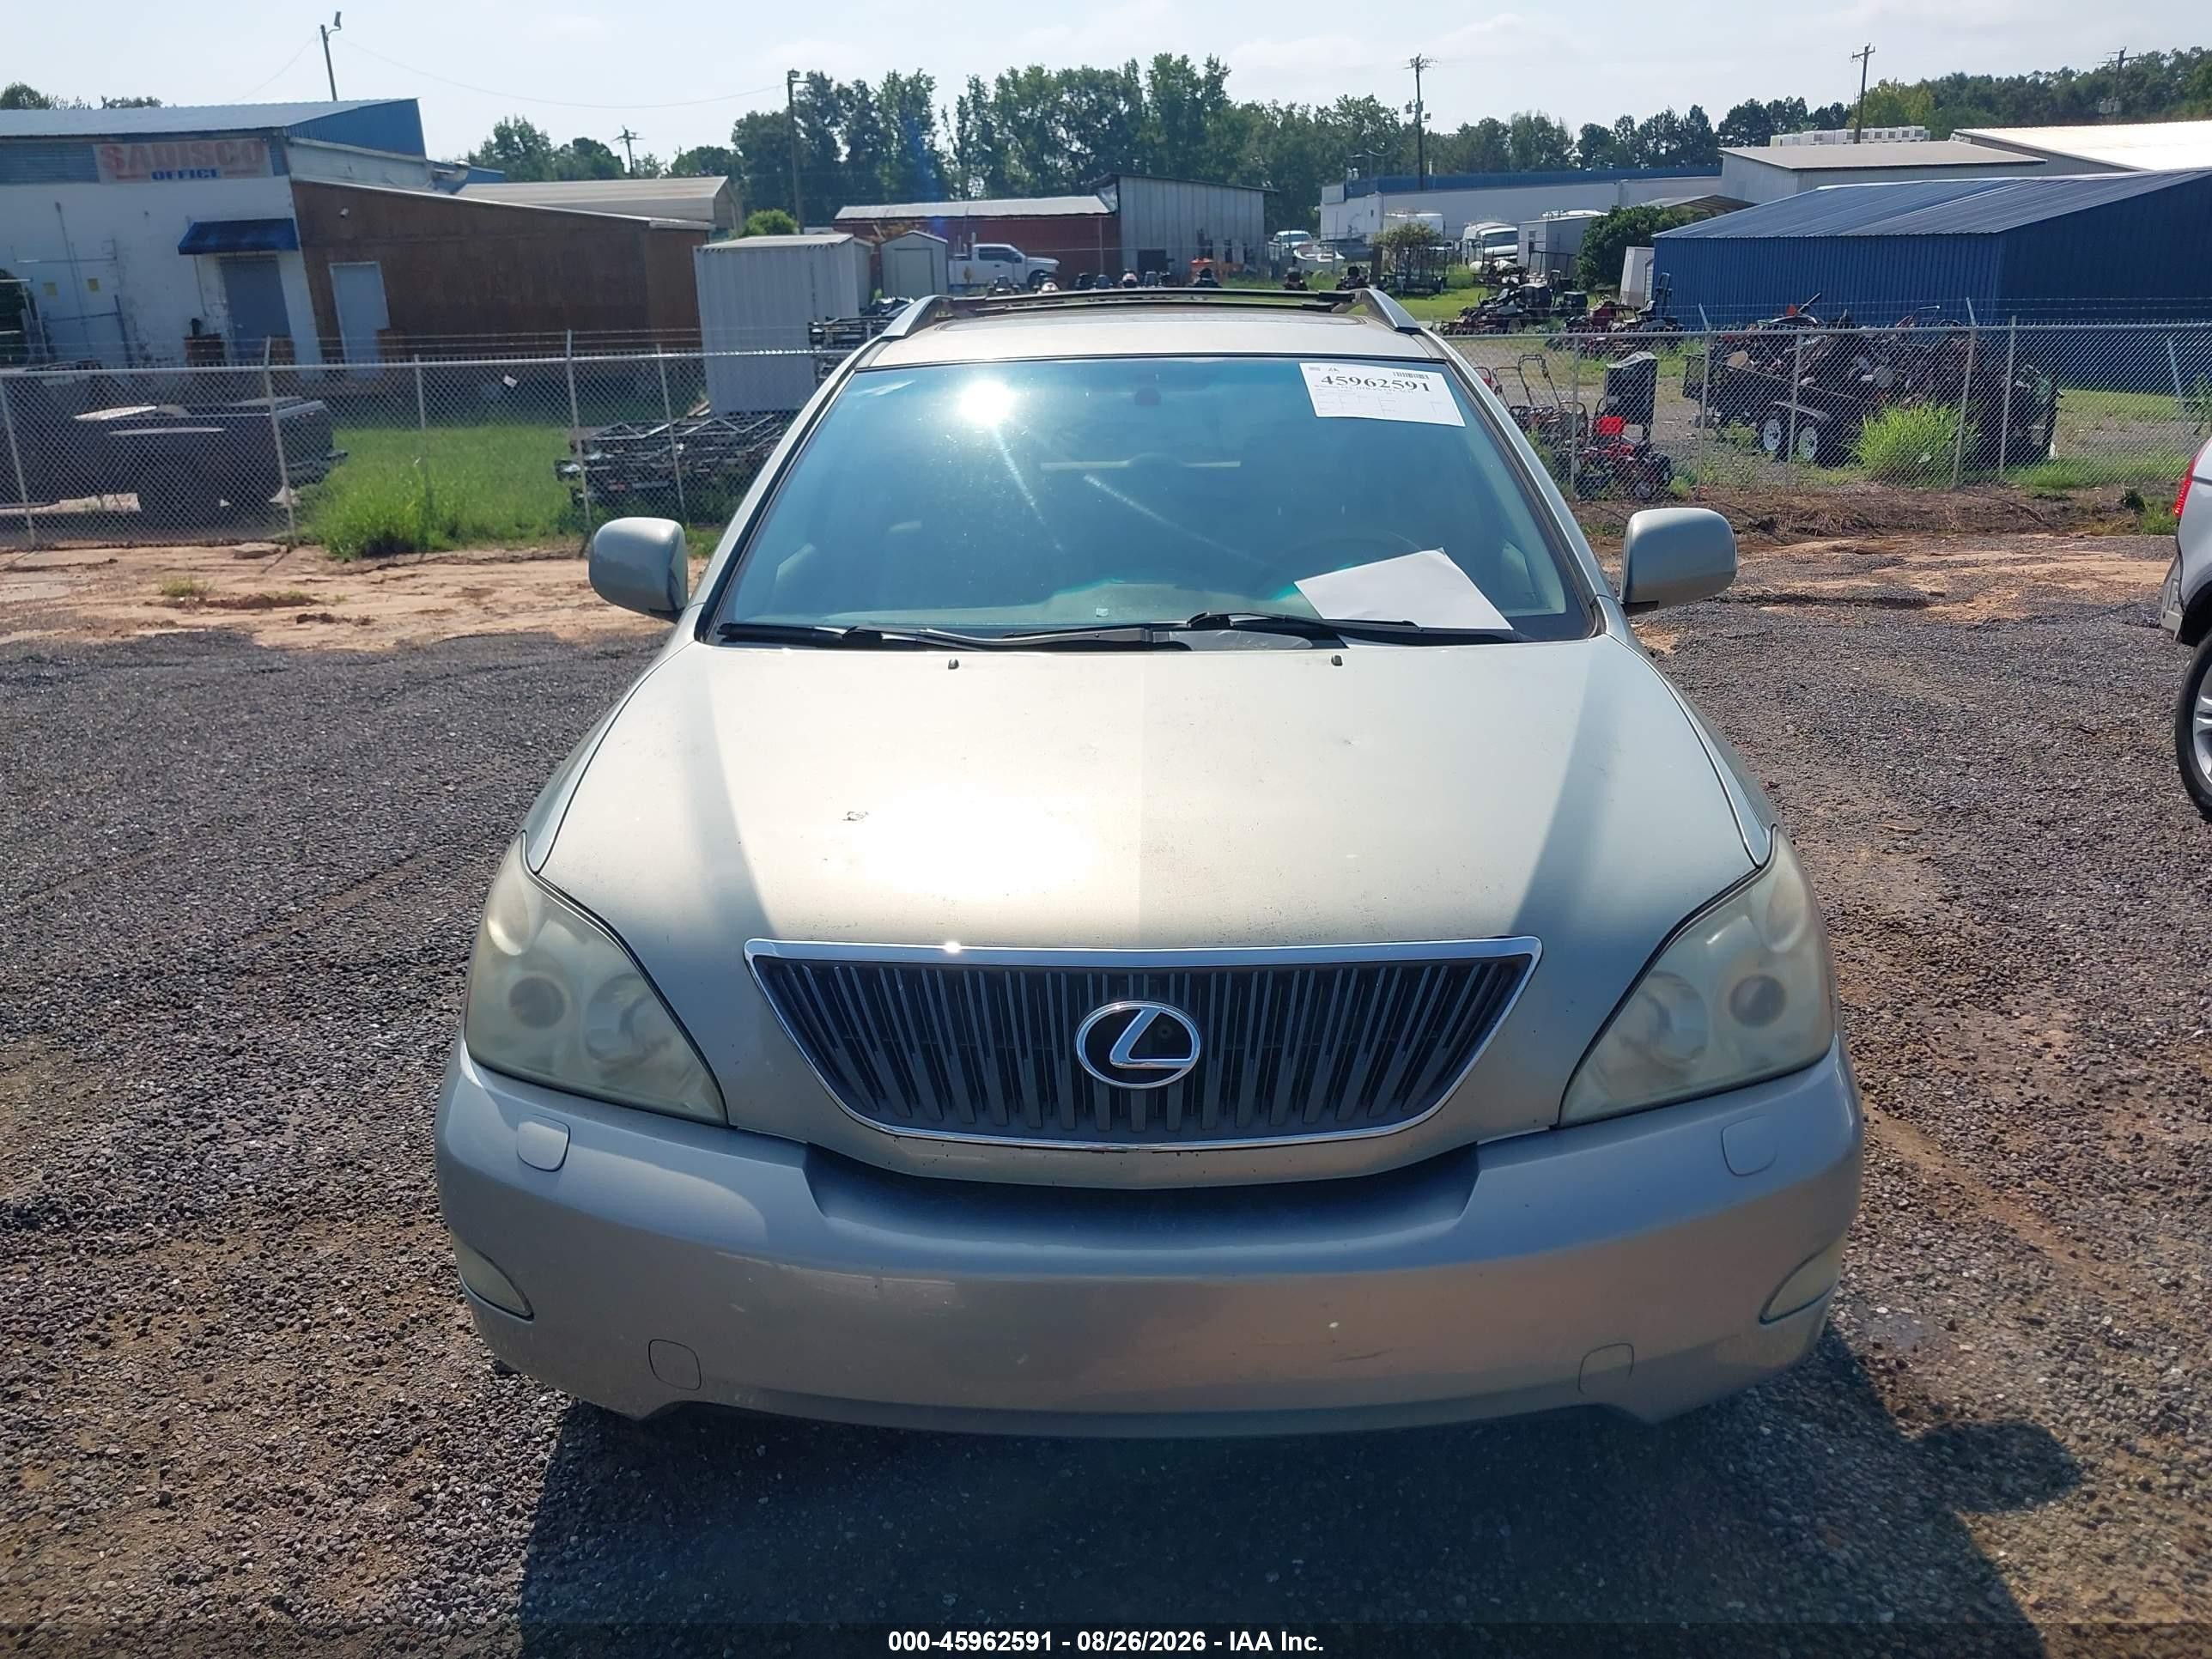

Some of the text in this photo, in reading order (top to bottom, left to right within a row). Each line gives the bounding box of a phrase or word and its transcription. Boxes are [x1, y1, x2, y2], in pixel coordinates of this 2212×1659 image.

[100, 137, 265, 173] SADISCO
[151, 168, 222, 180] OFFICE
[1321, 374, 1431, 392] 45962591
